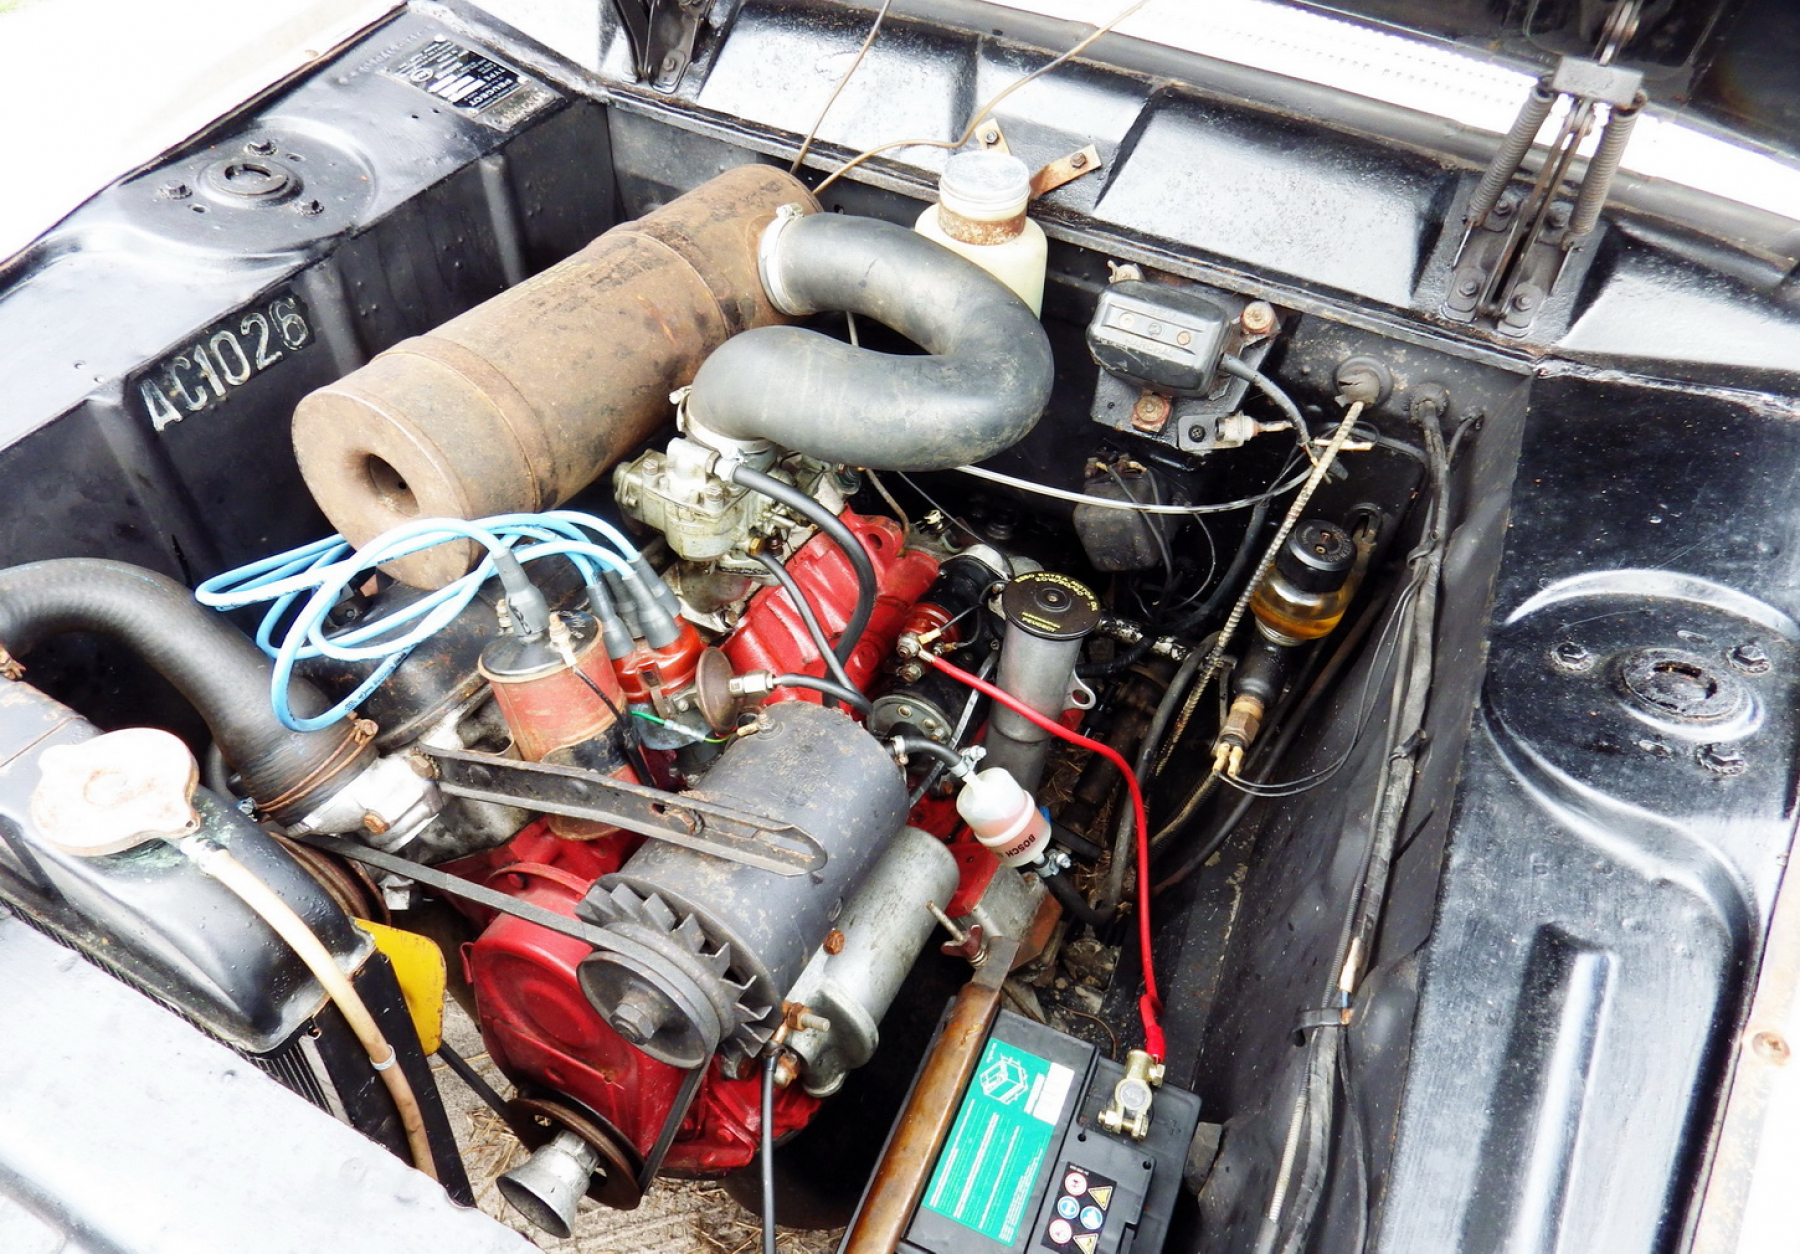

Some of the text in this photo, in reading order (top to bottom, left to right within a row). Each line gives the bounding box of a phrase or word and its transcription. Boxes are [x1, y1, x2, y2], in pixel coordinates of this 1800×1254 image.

[483, 68, 506, 82] TYPE
[468, 78, 514, 107] PEUGEOT
[139, 297, 309, 432] AC1026
[1015, 573, 1035, 583] ESSO
[1038, 573, 1068, 582] EXTRA
[1071, 580, 1094, 600] MOTOR
[1022, 617, 1056, 632] PEUGEOT
[1005, 834, 1036, 857] BOSCH
